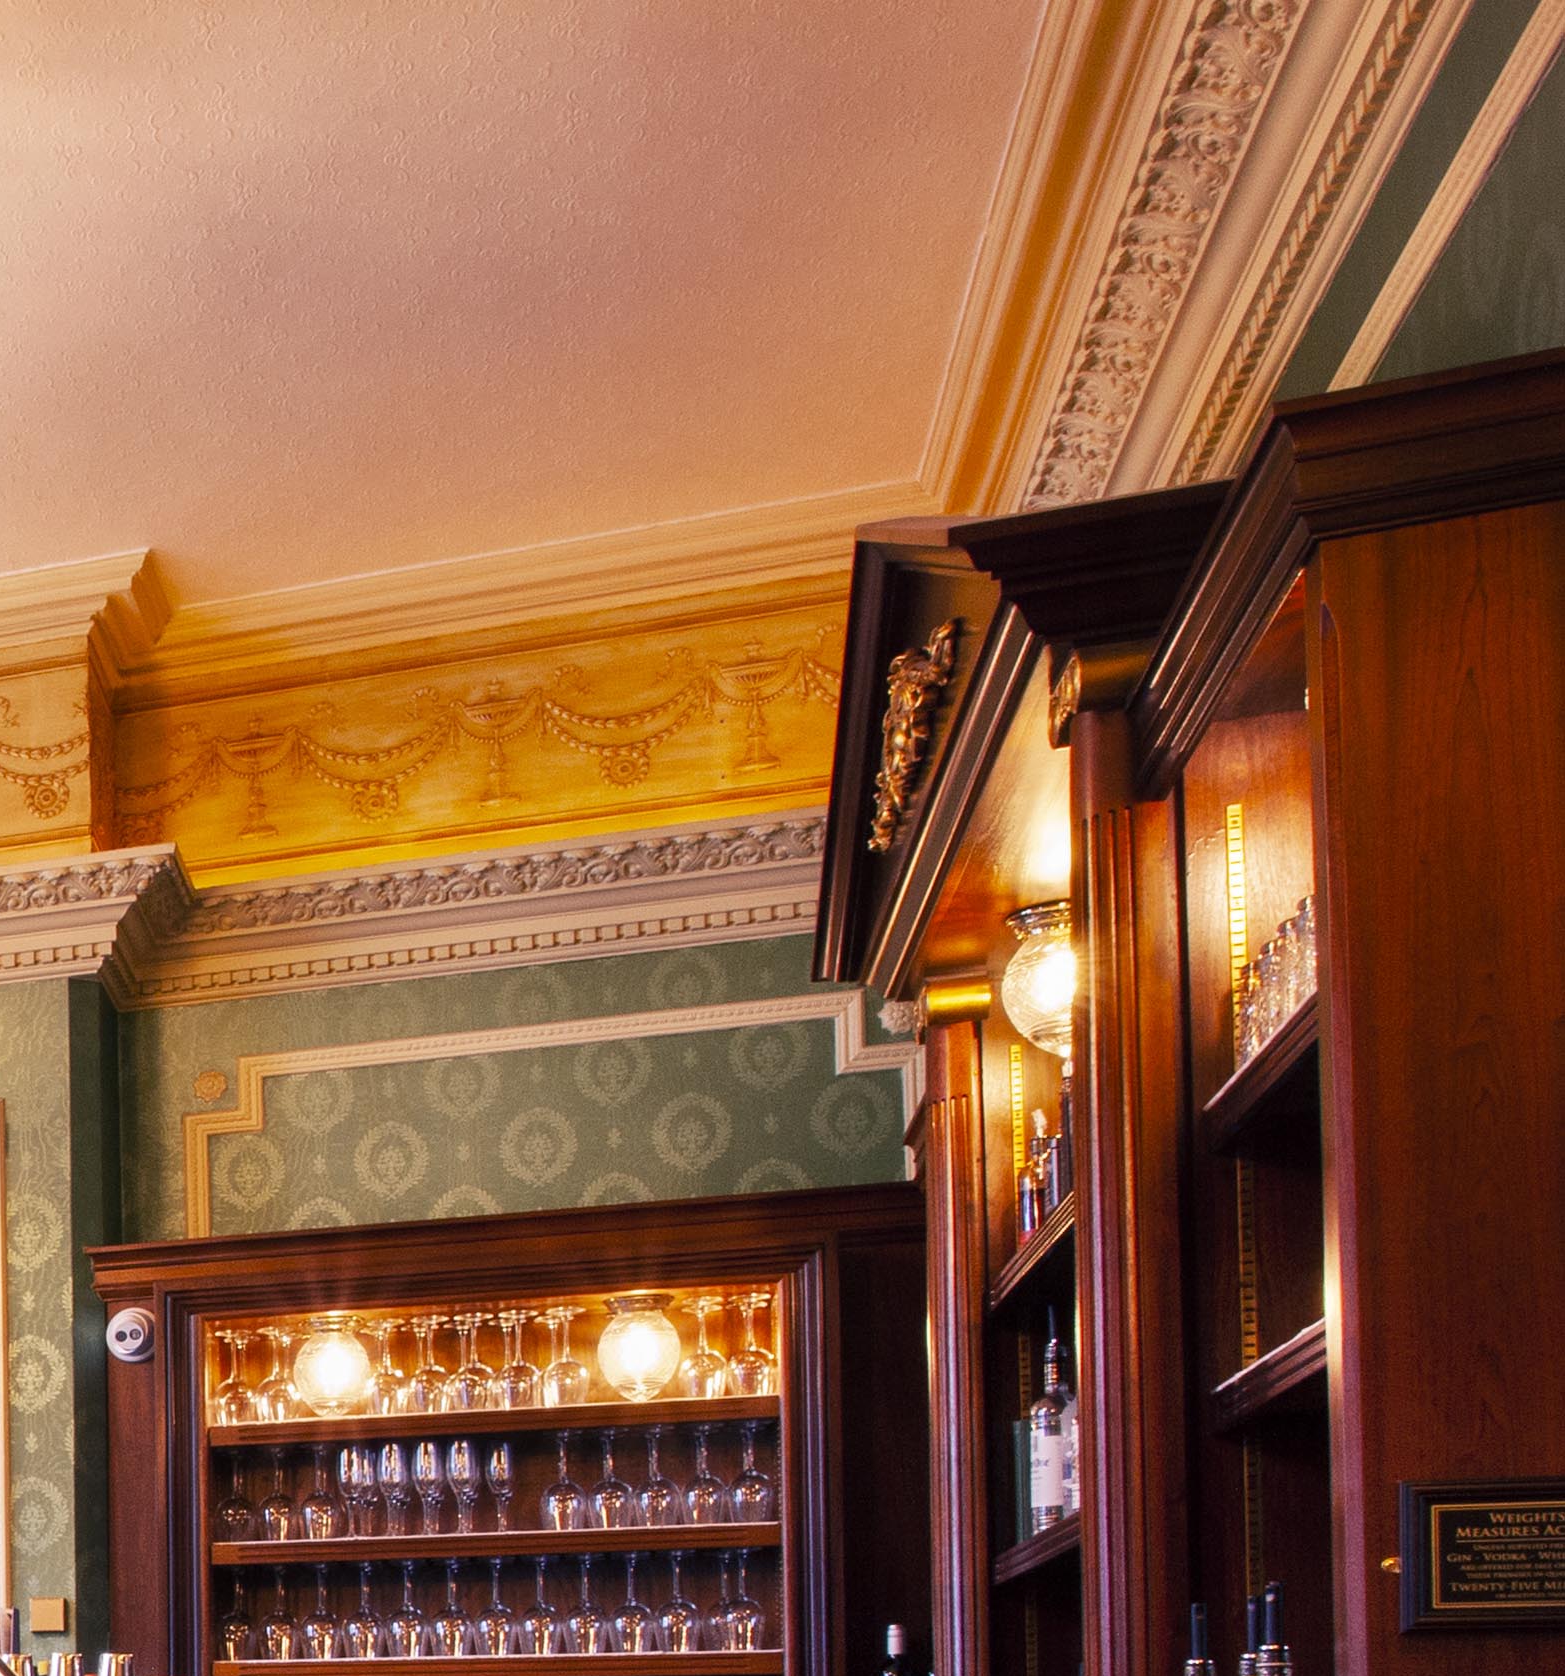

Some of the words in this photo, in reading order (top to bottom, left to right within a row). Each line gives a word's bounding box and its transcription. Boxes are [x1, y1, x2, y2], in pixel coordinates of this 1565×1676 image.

[1489, 1512, 1565, 1523] WEIGHTS
[1456, 1526, 1539, 1537] MEASURES
[1447, 1553, 1471, 1562] GIN
[1483, 1552, 1527, 1561] VODKA
